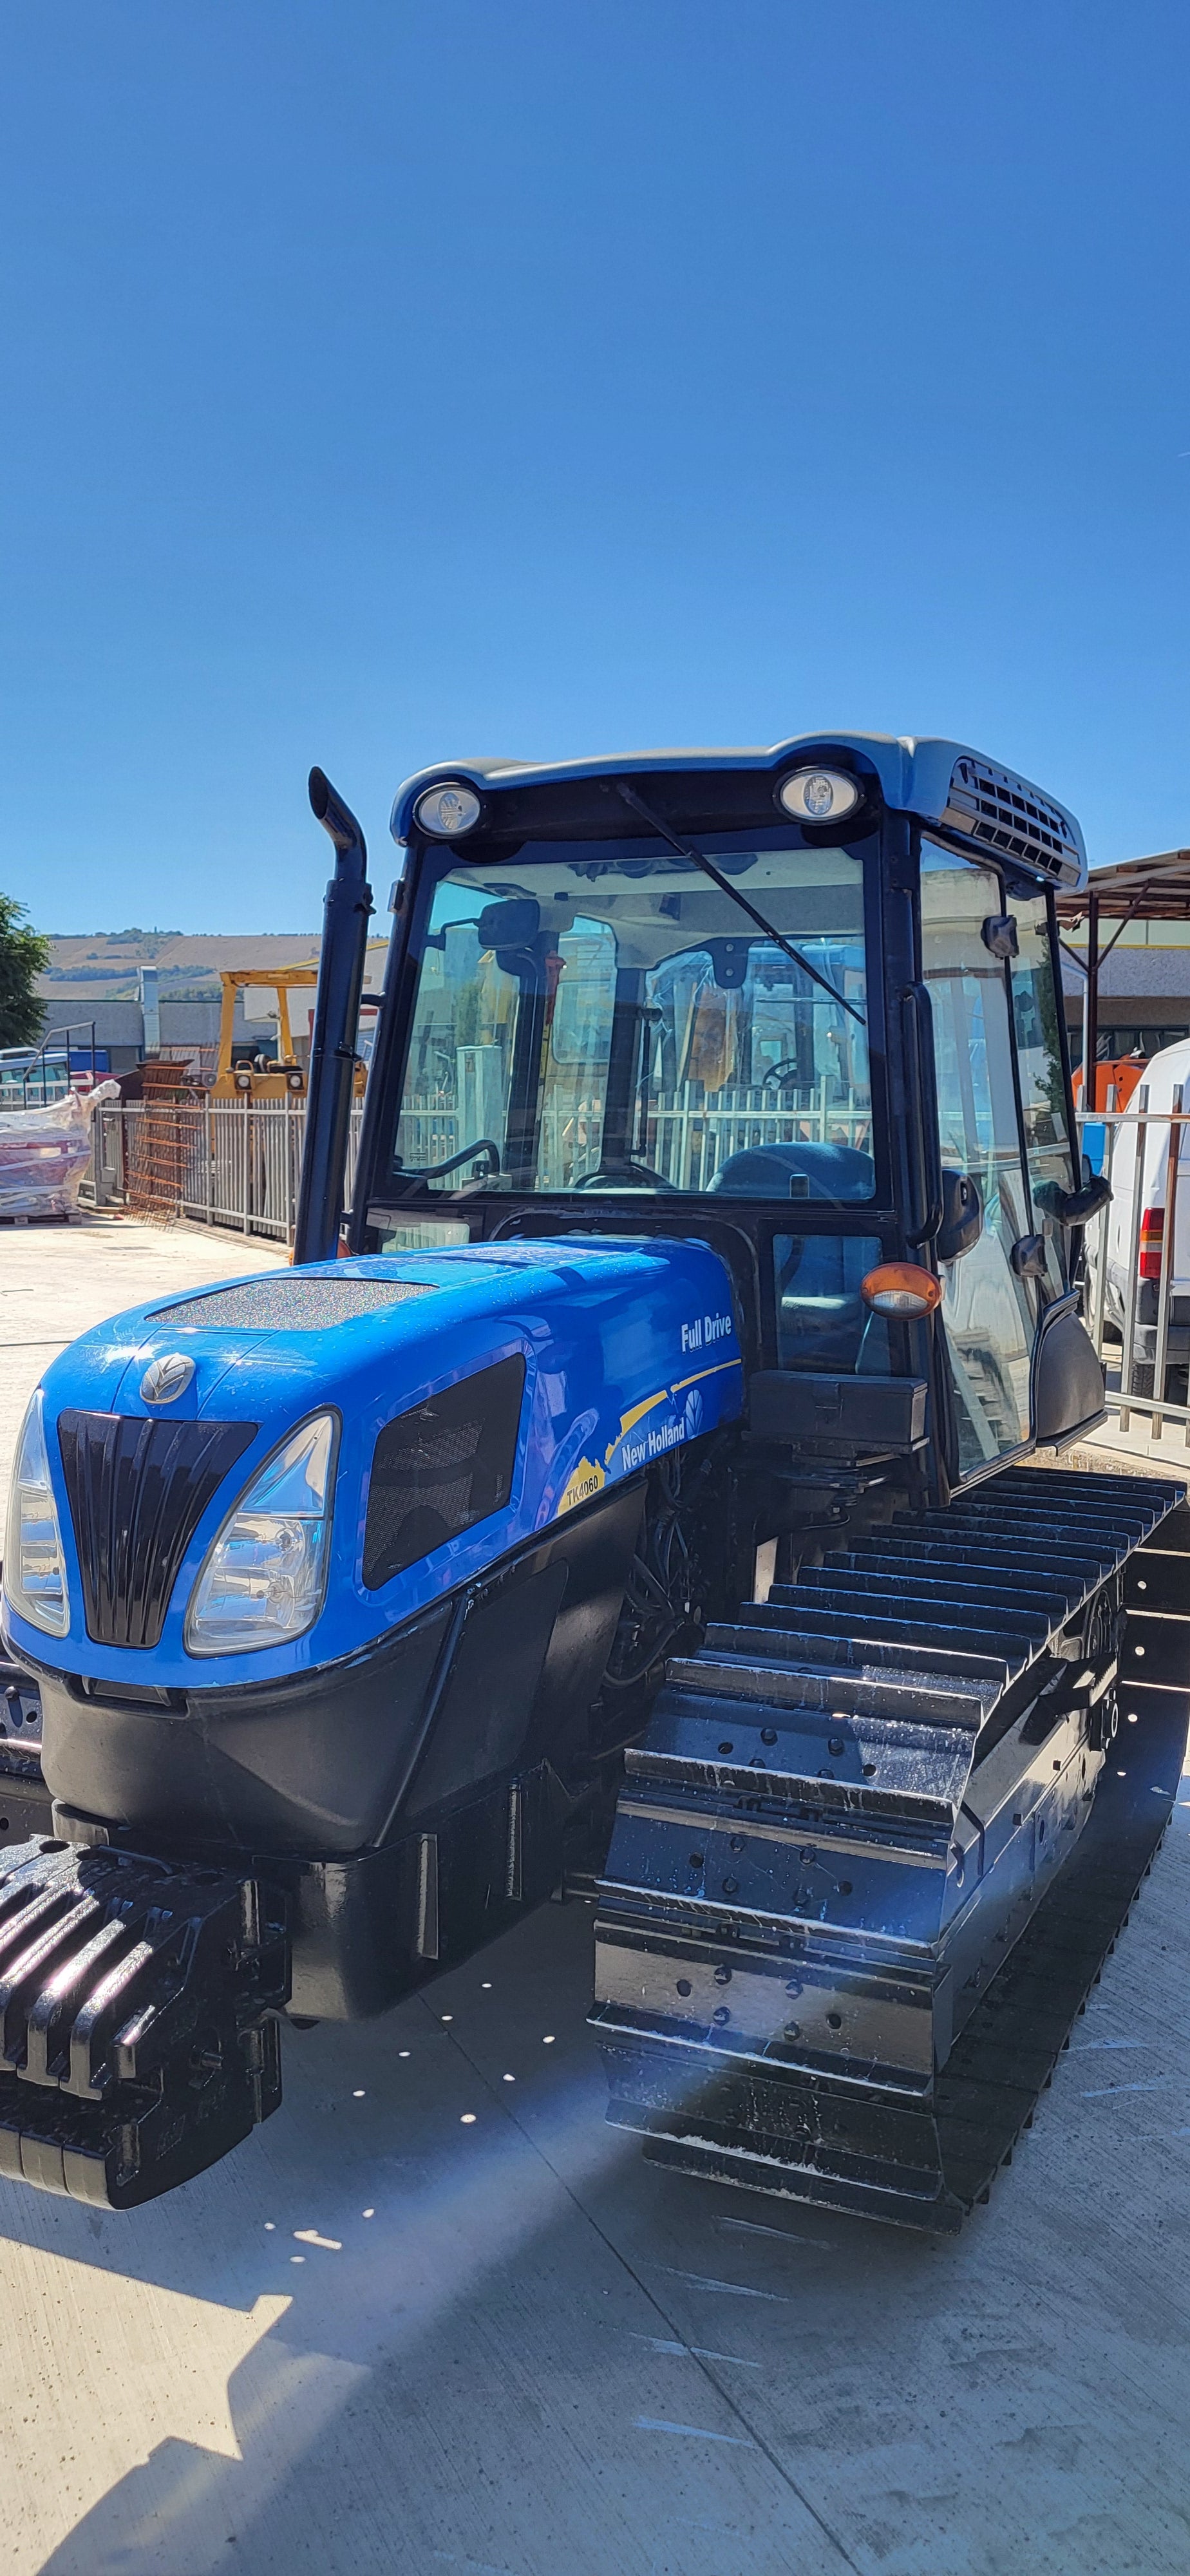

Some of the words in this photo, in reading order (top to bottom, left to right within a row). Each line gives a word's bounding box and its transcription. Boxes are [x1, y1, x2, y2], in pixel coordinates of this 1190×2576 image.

[681, 1319, 702, 1352] Full
[704, 1312, 732, 1343] Drive
[621, 1444, 646, 1472] New
[648, 1416, 685, 1457] Holland
[567, 1475, 598, 1506] TK4060
